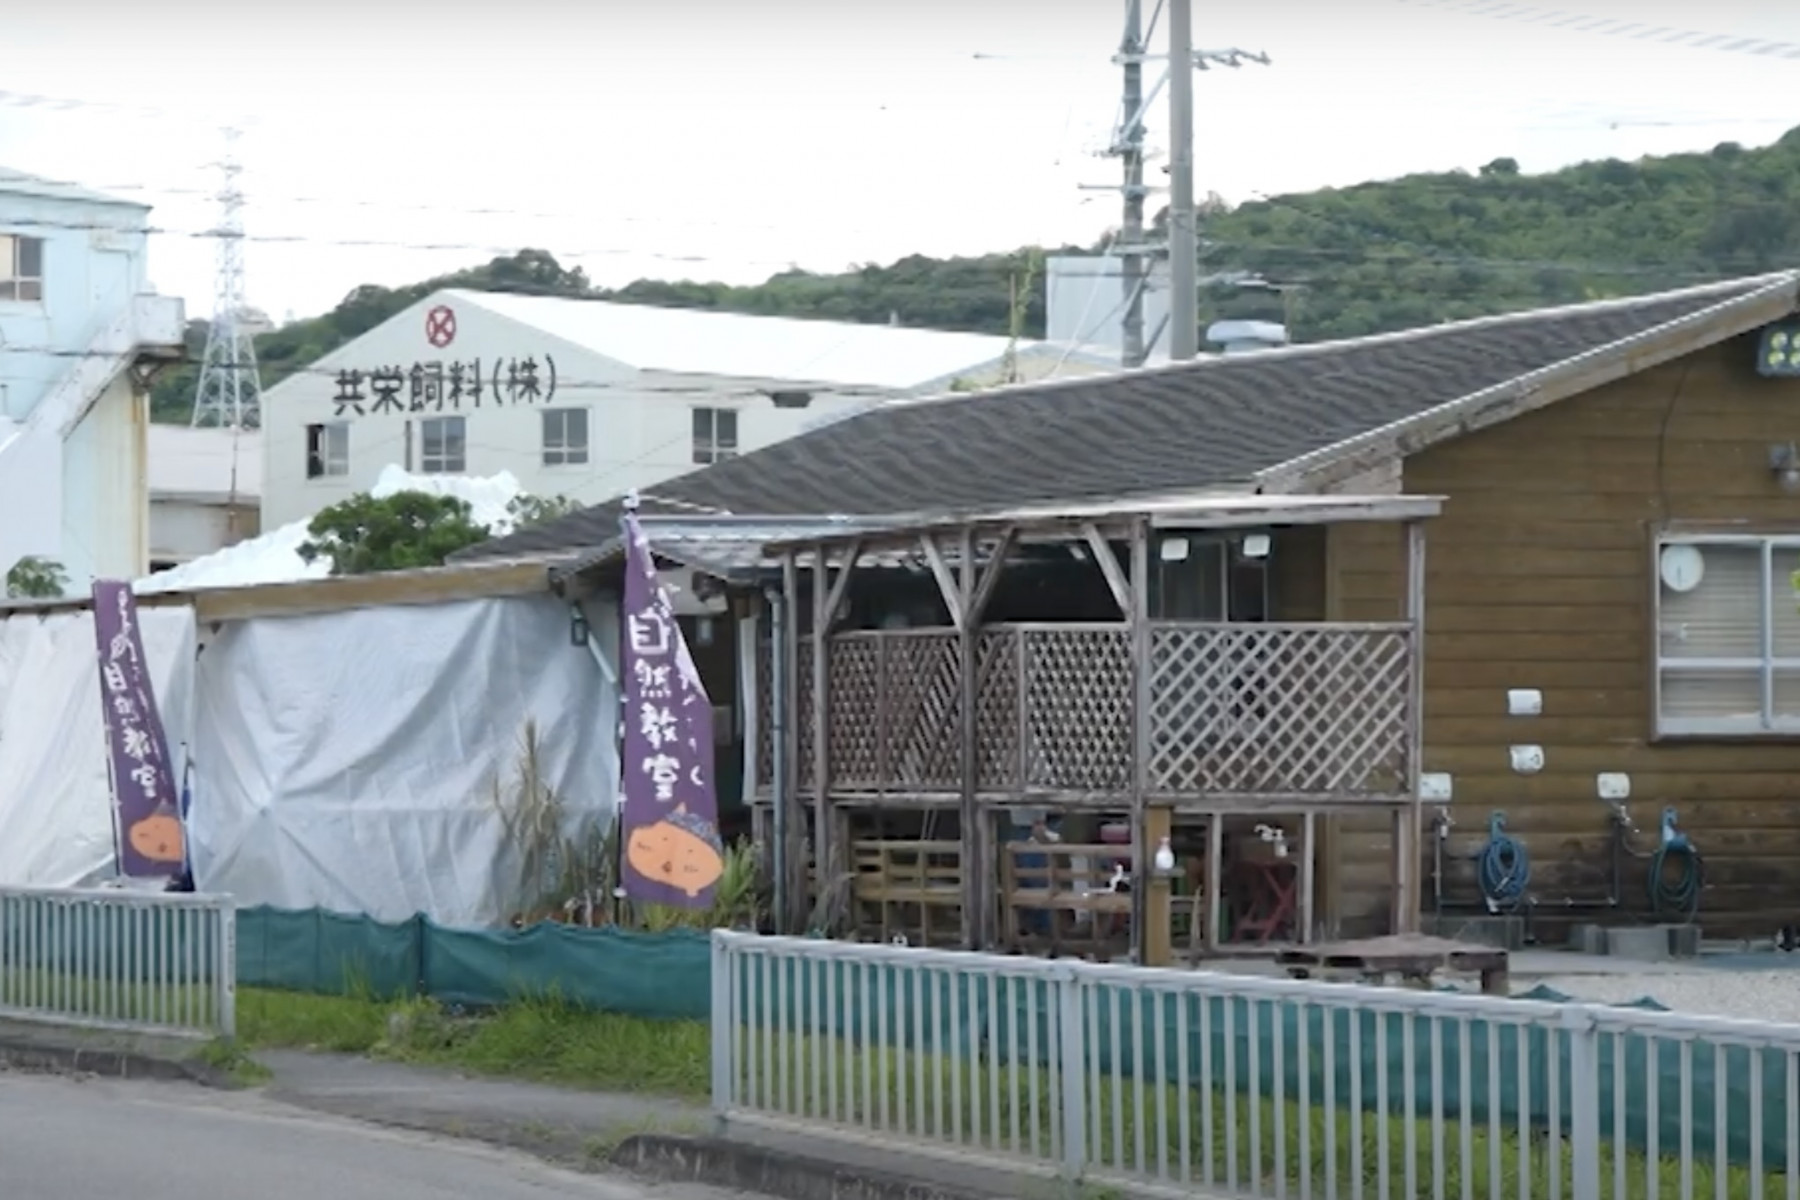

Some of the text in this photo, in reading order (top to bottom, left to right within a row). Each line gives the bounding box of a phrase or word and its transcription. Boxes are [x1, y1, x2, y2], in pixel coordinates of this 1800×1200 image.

[332, 353, 557, 416] 共栄飼料(株)
[627, 605, 681, 801] 自然教室
